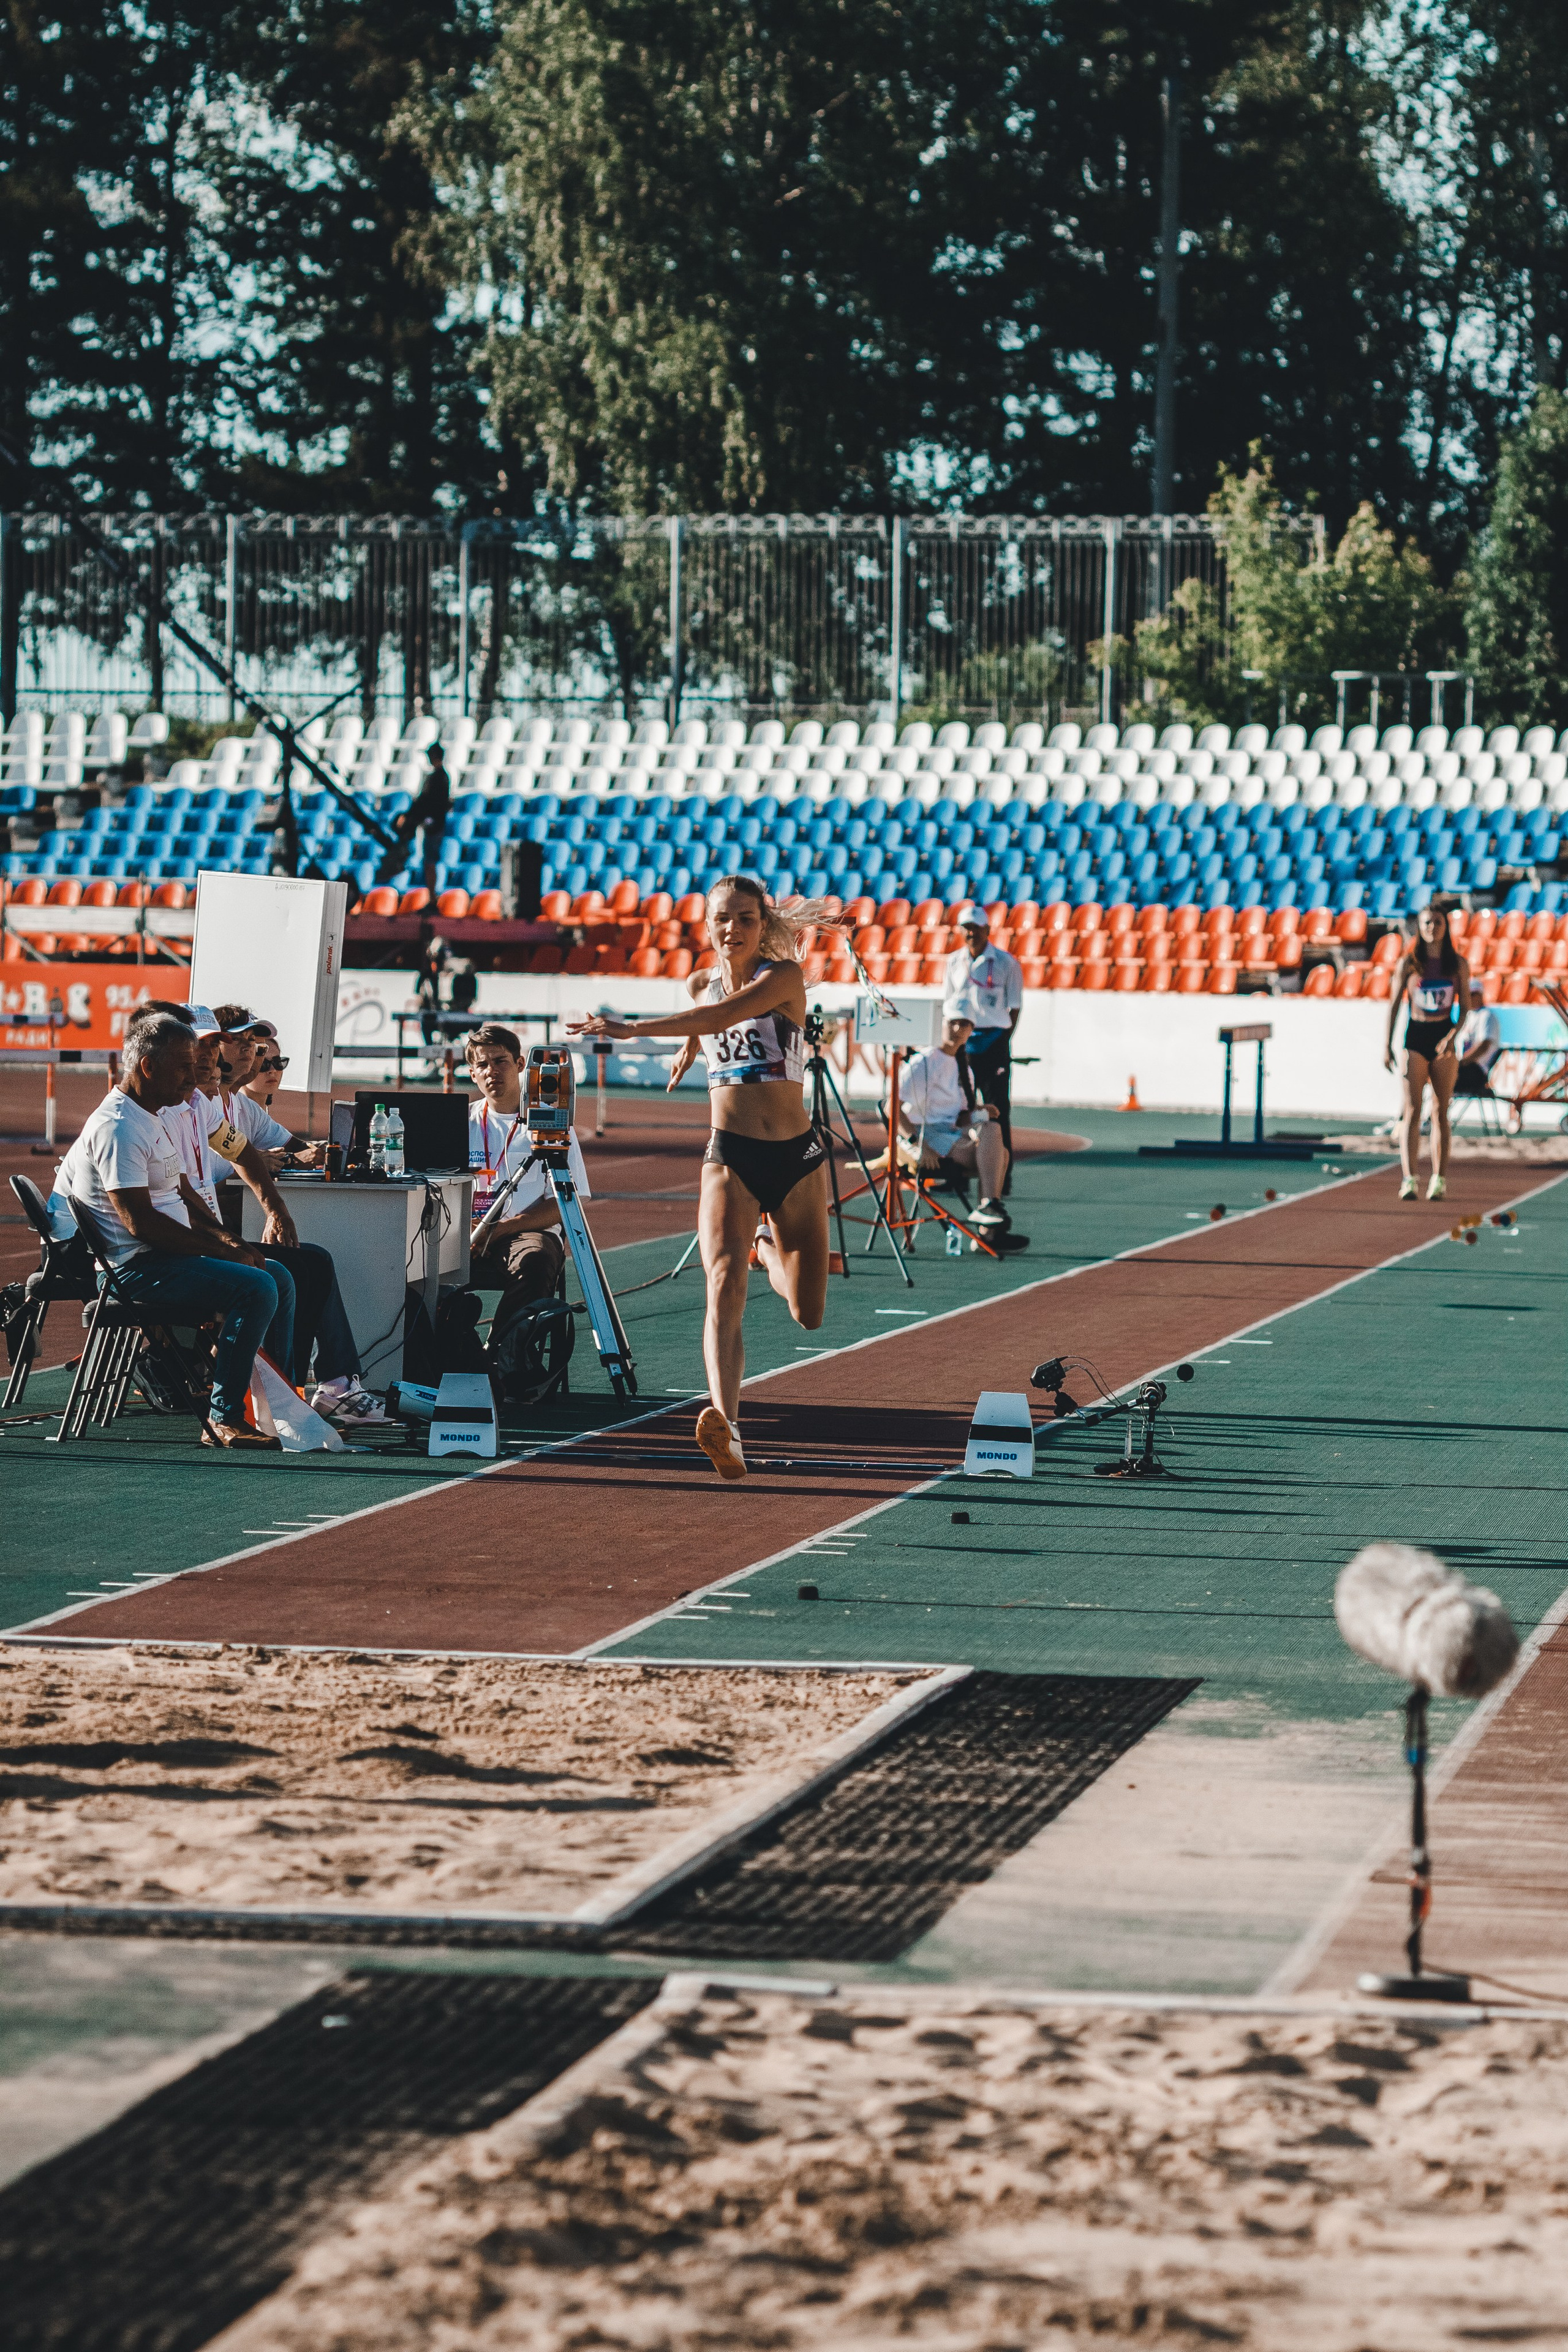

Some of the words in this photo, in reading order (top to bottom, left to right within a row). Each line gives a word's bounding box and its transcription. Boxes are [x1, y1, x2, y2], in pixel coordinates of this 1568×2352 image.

[714, 1028, 767, 1063] 326
[803, 1148, 822, 1159] adidas
[977, 1452, 1017, 1460] MONDO
